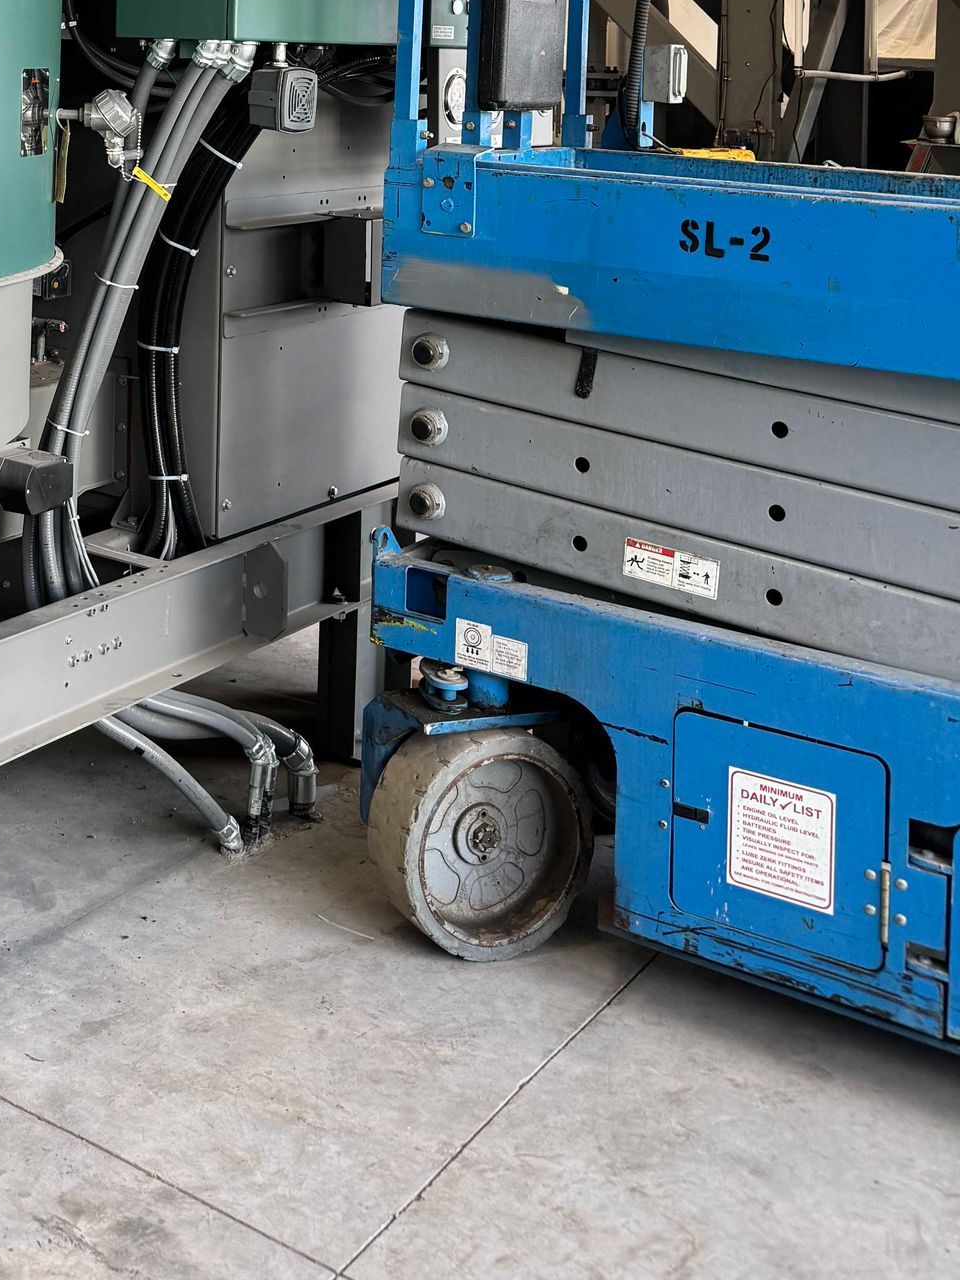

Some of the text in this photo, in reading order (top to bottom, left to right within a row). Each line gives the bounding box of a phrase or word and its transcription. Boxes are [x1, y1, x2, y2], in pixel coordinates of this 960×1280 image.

[679, 219, 770, 262] SL-2
[641, 544, 663, 555] DANGER
[760, 784, 803, 802] MINIMUM
[741, 789, 822, 819] DAILY LIST
[743, 805, 799, 825] ENGINE OIL LEVEL
[742, 813, 820, 839] HYDRAULIC FLUID LEVEL
[743, 820, 777, 834] BATTERIES
[743, 827, 791, 846] TIRE PRESSURE
[742, 835, 771, 848] VISUALLY
[773, 844, 799, 856] INSPECT
[742, 850, 806, 873] LUBE ZERK FITTINGS
[742, 858, 764, 868] INSURE
[779, 869, 804, 880] SAFETY
[805, 876, 824, 886] ITEMS
